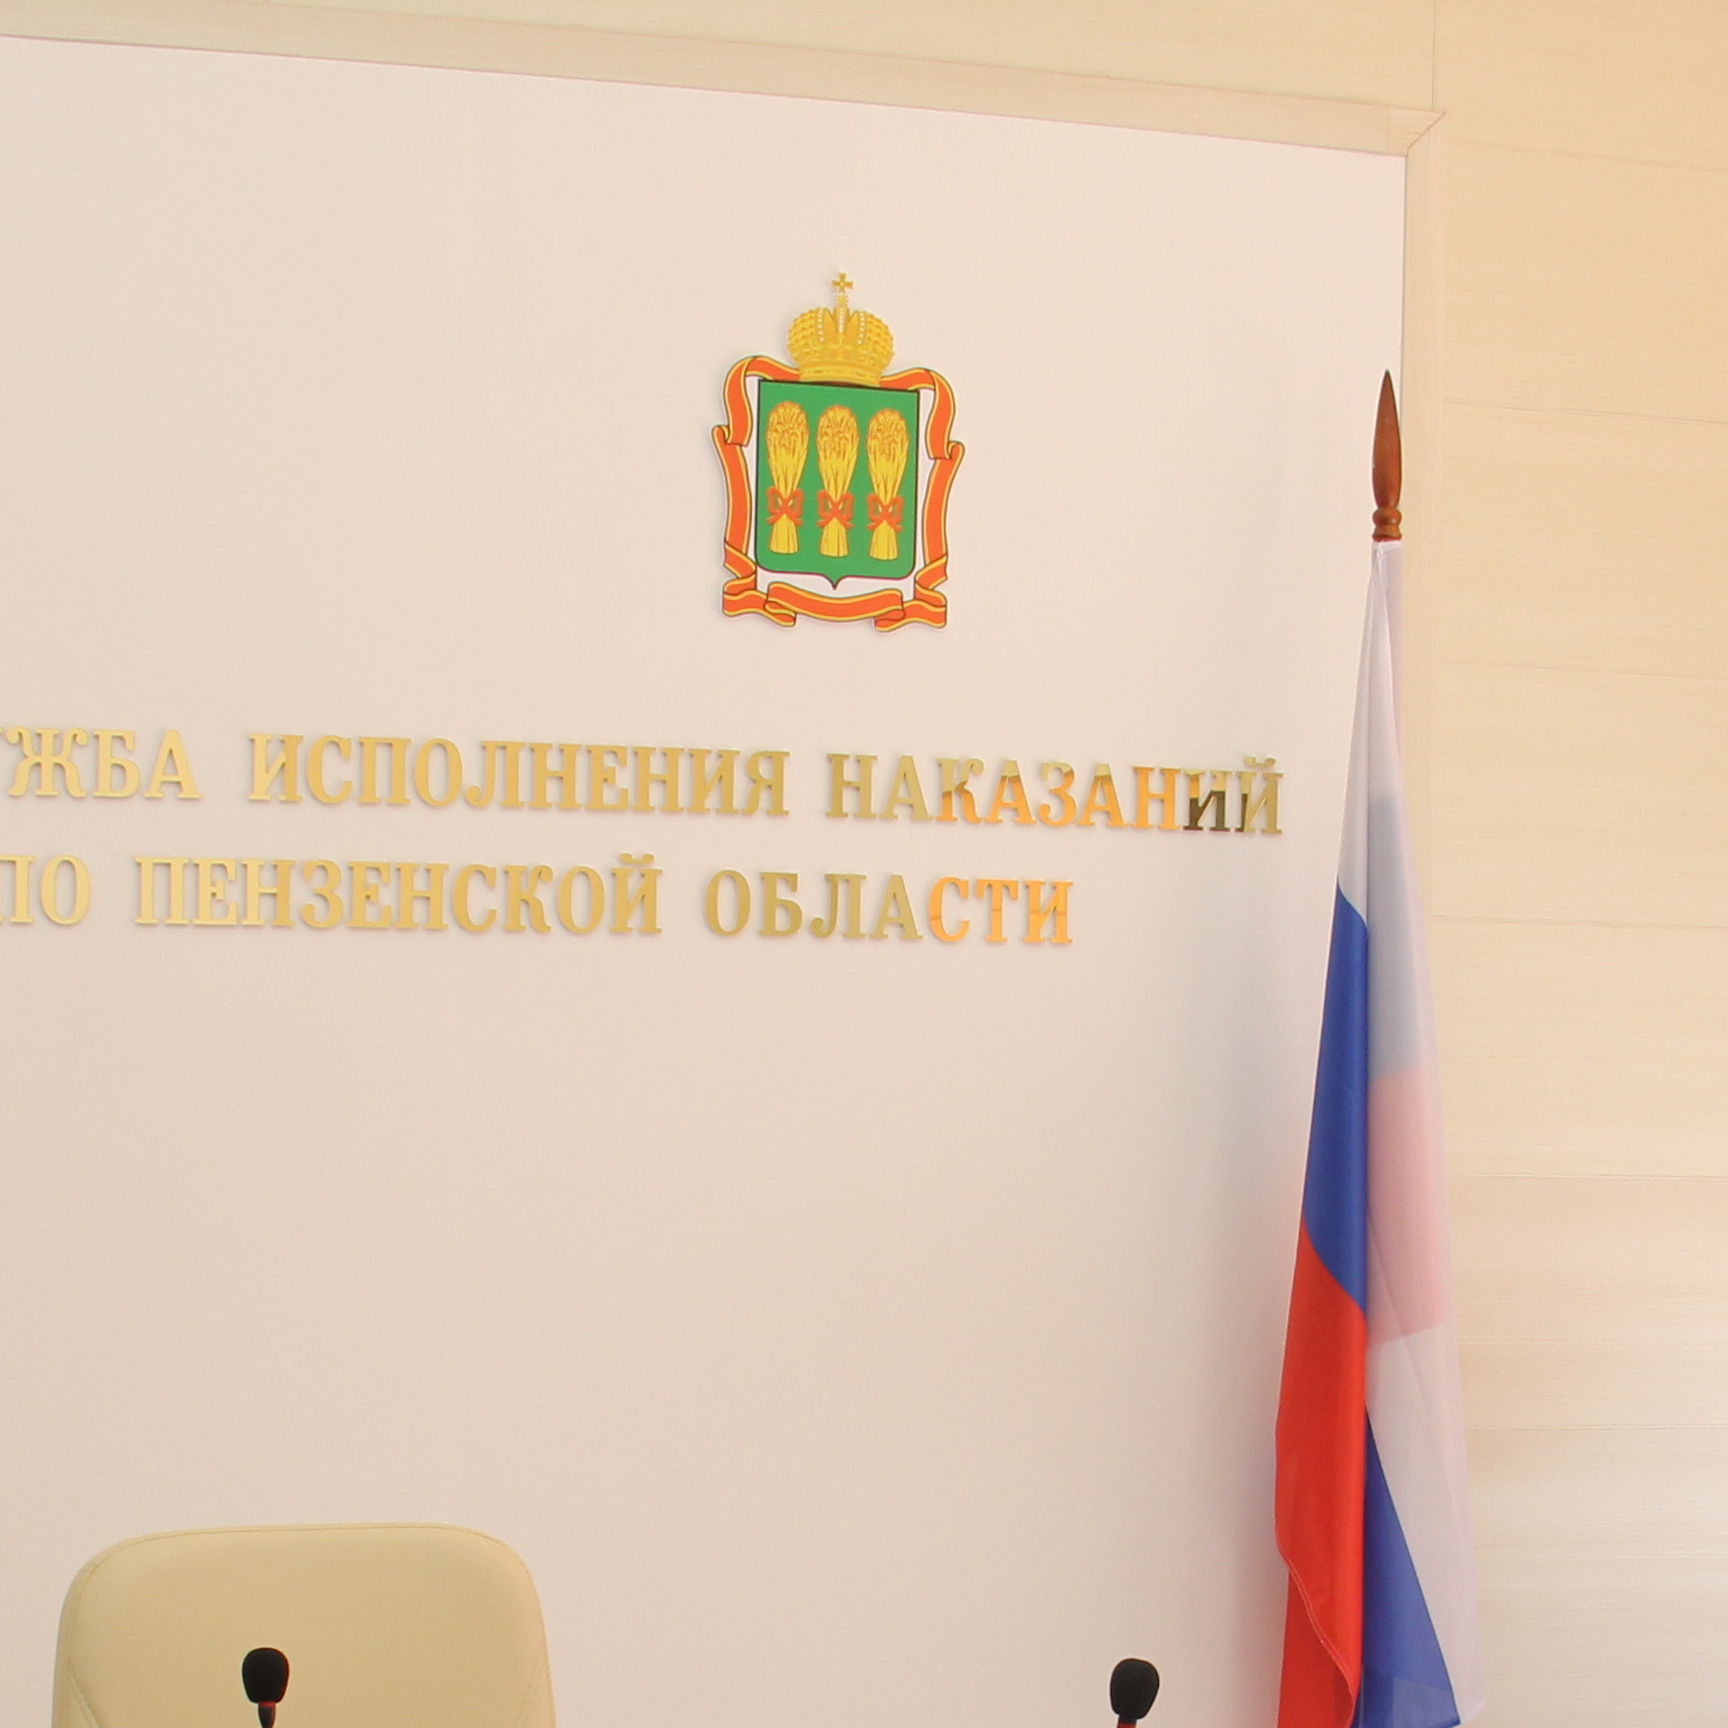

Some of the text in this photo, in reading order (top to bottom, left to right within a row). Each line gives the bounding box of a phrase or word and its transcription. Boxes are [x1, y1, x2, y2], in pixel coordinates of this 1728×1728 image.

[248, 730, 791, 818] ИСПОЛНЕНИЯ
[825, 752, 1284, 835] НАКАЗАНИЙ
[134, 853, 664, 934] ПЕНЗЕНСКОЙ
[704, 868, 1073, 945] ОБЛАСТИ
